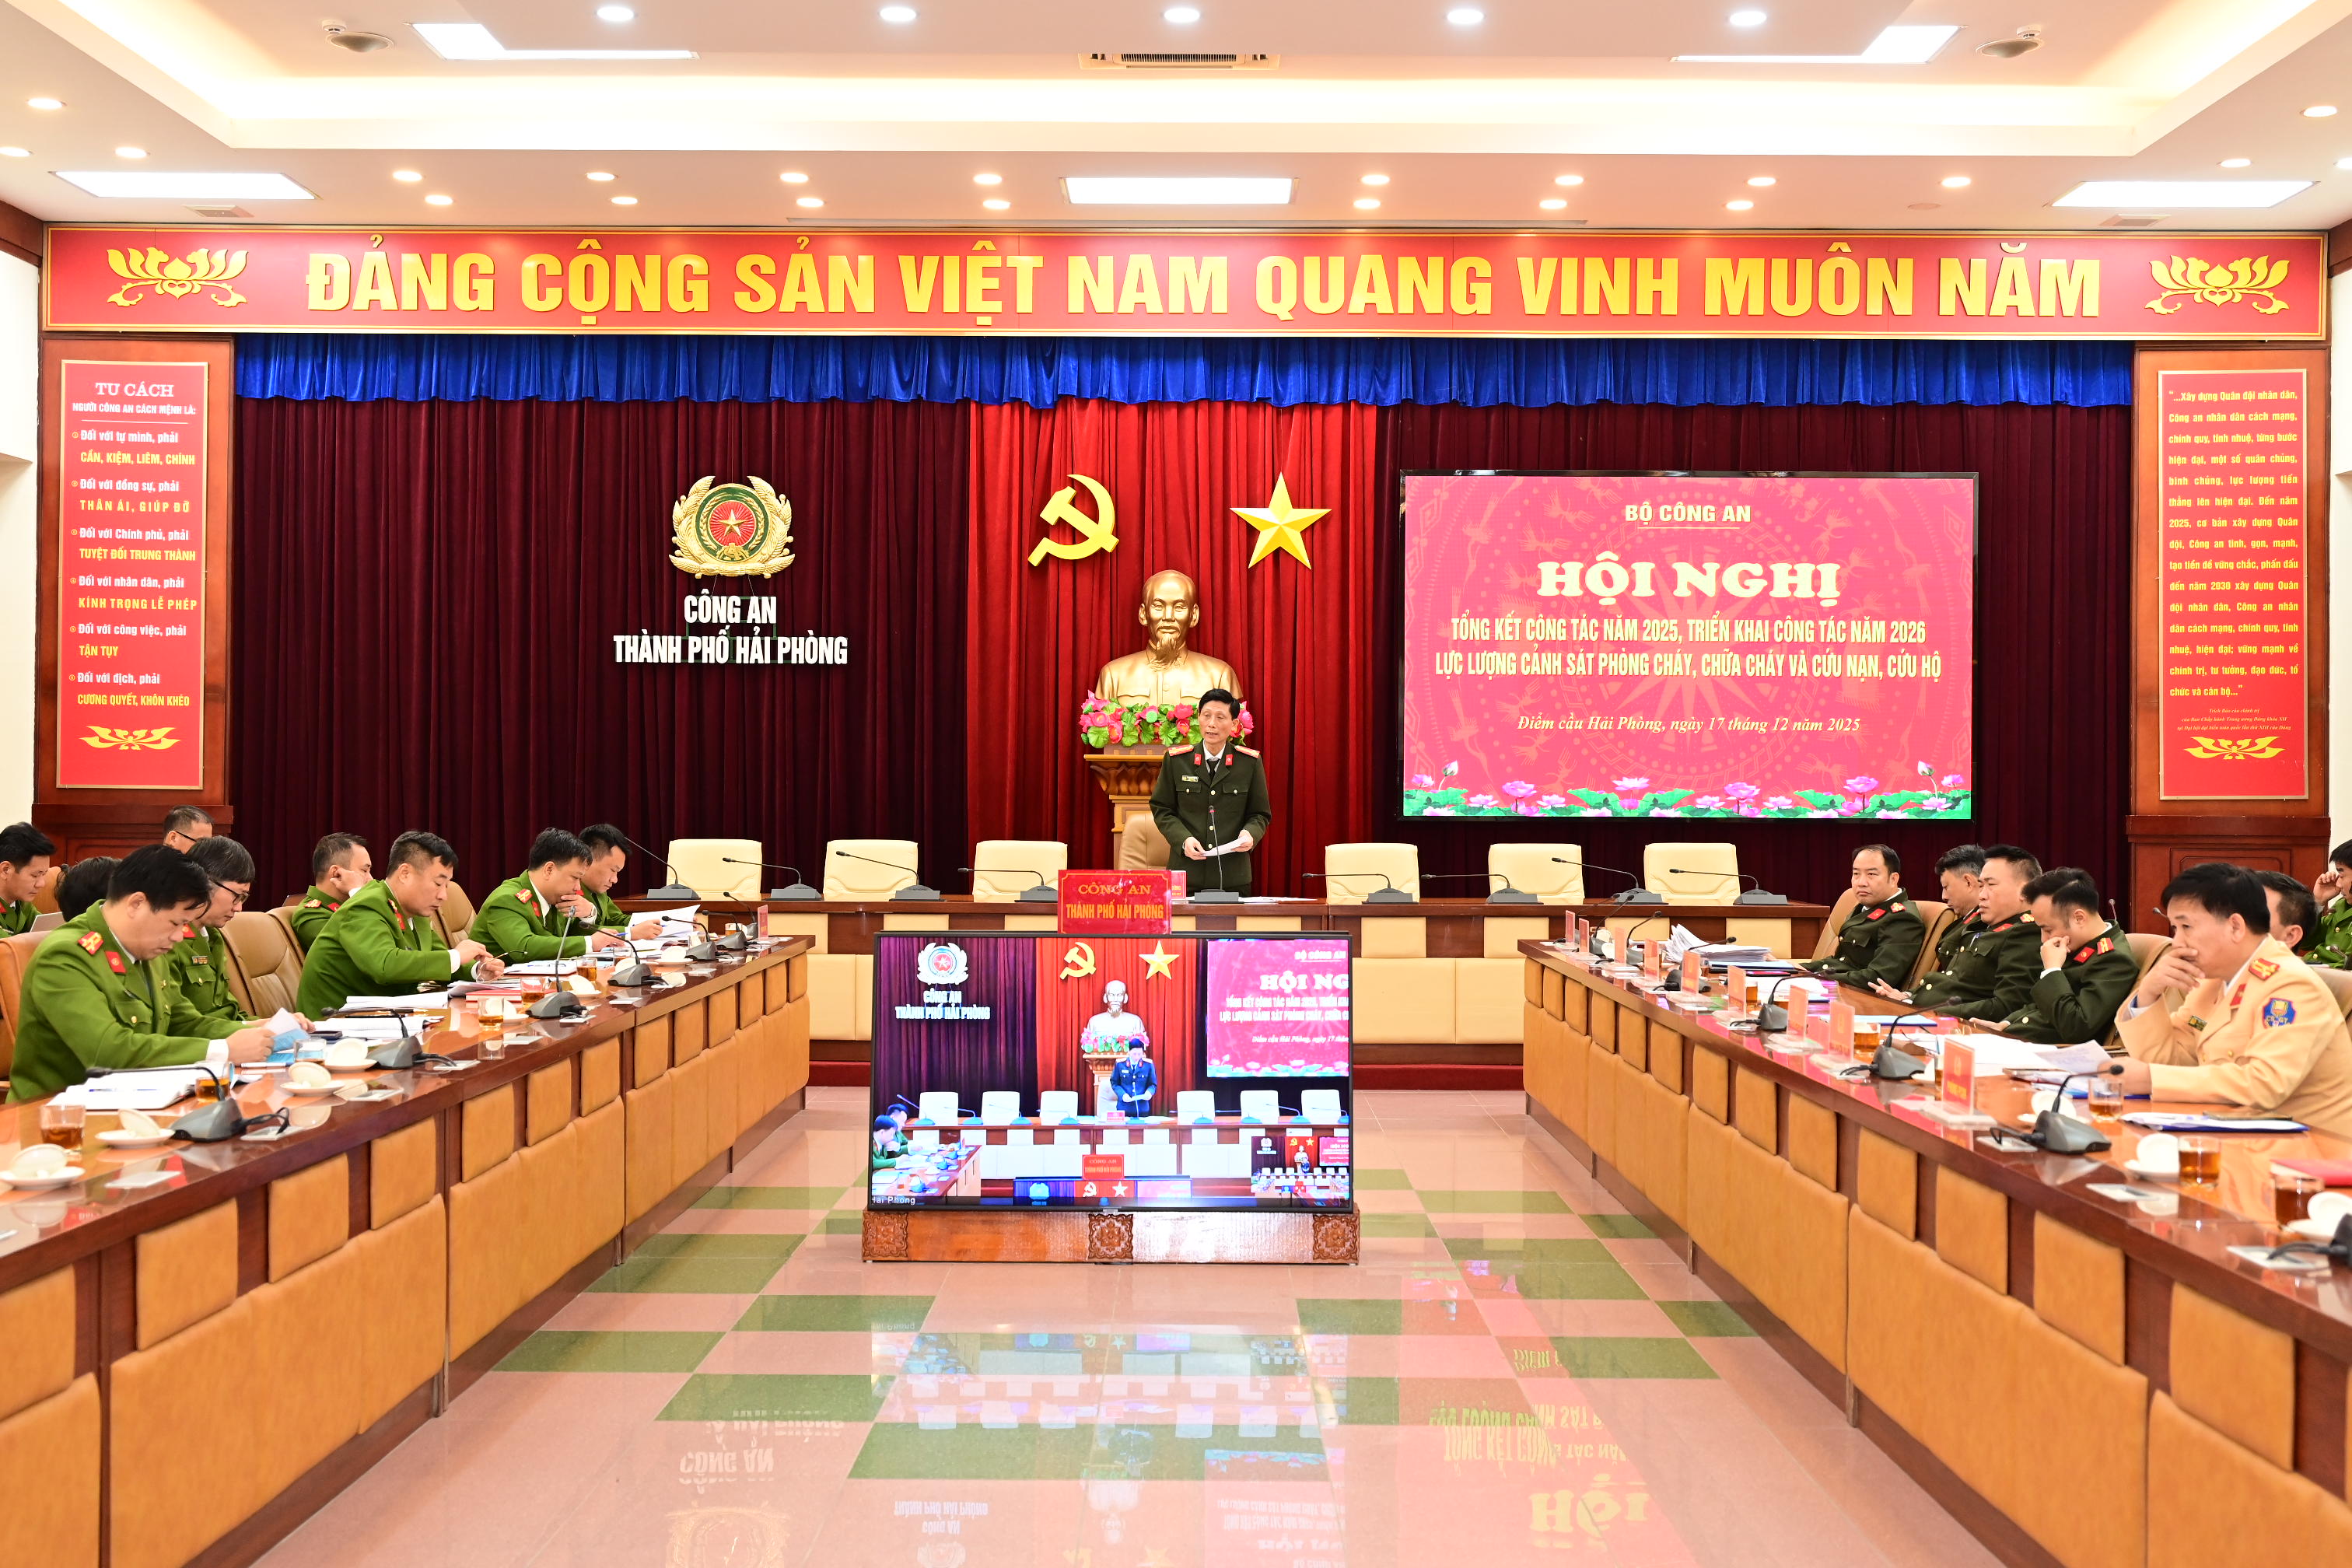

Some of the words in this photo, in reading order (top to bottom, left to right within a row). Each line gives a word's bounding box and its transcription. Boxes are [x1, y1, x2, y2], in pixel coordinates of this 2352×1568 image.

[306, 234, 495, 311] ĐẢNG
[521, 239, 709, 325] CỘNG
[733, 236, 875, 313] SẢN
[898, 240, 1044, 326] VIỆT
[1067, 255, 1228, 313] NAM
[1255, 254, 1492, 321] QUANG
[1516, 257, 1678, 315] VINH
[1705, 242, 1914, 317] MUÔN
[1939, 242, 2100, 317] NĂM
[124, 381, 173, 397] CÁCH
[122, 404, 133, 412] AN
[136, 403, 156, 413] CÁCH
[184, 404, 195, 414] LÀ:
[81, 429, 96, 440] Đối
[99, 430, 113, 440] với
[116, 431, 125, 443] tự
[128, 431, 154, 443] mình,
[158, 431, 177, 443] phải
[107, 450, 133, 464] KIỆM,
[137, 451, 162, 464] LIÊM,
[166, 452, 194, 464] CHÍNH
[80, 478, 95, 488] Đối
[99, 478, 112, 489] với
[116, 478, 138, 492] đồng
[142, 481, 155, 492] sự,
[159, 479, 178, 492] phải
[80, 499, 111, 510] THÂN
[117, 499, 134, 512] ÁI,
[139, 499, 169, 512] GIÚP
[1626, 502, 1652, 524] BỘ
[1659, 502, 1715, 521] CÔNG
[1722, 506, 1750, 521] AN
[79, 526, 95, 537] Đối
[98, 528, 112, 538] với
[115, 528, 142, 539] Chính
[145, 528, 165, 541] phủ,
[168, 528, 188, 541] phải
[79, 547, 107, 560] TUYỆT
[110, 547, 126, 559] ĐỐI
[130, 549, 161, 560] TRUNG
[164, 548, 195, 560] THÀNH
[79, 574, 93, 586] Đối
[97, 576, 110, 586] với
[114, 576, 137, 586] nhân
[141, 576, 160, 588] dân,
[163, 576, 184, 588] phải
[1537, 551, 1655, 604] HỘI
[1671, 562, 1840, 605] NGHỊ
[79, 596, 106, 607] KÍNH
[110, 598, 147, 610] TRỌNG
[152, 597, 163, 609] LỄ
[168, 597, 196, 610] PHÉP
[684, 589, 741, 624] CÔNG
[747, 596, 777, 624] AN
[79, 621, 93, 633] Đối
[96, 623, 110, 634] với
[114, 624, 137, 635] công
[140, 624, 163, 636] việc,
[166, 624, 186, 635] phải
[1451, 610, 1489, 640] TỔNG
[1495, 611, 1522, 640] KẾT
[1526, 614, 1566, 641] CÔNG
[1570, 614, 1598, 640] TÁC
[1603, 615, 1637, 640] NĂM
[1642, 619, 1682, 642] 2025,
[1687, 611, 1729, 641] TRIỂN
[1734, 620, 1769, 641] KHAI
[1774, 616, 1814, 642] CÔNG
[1818, 616, 1846, 642] TÁC
[1850, 617, 1885, 642] NĂM
[1890, 621, 1925, 642] 2026
[79, 643, 97, 657] TẬN
[100, 646, 117, 657] TỤY
[613, 629, 682, 663] THÀNH
[688, 625, 730, 663] PHỐ
[736, 626, 772, 664] HẢI
[777, 630, 848, 664] PHÒNG
[1436, 650, 1462, 678] LỰC
[1468, 651, 1517, 679] LƯỢNG
[1521, 644, 1561, 674] CẢNH
[1566, 649, 1594, 674] SÁT
[1598, 649, 1649, 675] PHÒNG
[1654, 649, 1696, 677] CHÁY,
[1701, 649, 1741, 676] CHỮA
[1745, 649, 1784, 676] CHÁY
[1789, 650, 1808, 676] VÀ
[1812, 649, 1841, 677] CỨU
[1846, 655, 1882, 681] NẠN,
[1888, 649, 1916, 677] CỨU
[1921, 651, 1941, 681] HỘ
[77, 670, 93, 682] Đối
[96, 672, 110, 682] với
[113, 672, 136, 684] dịch,
[139, 672, 159, 684] phải
[110, 692, 138, 705] QUYẾT,
[141, 693, 164, 705] KHÔN
[1517, 712, 1553, 729] Điểm
[1559, 712, 1583, 729] cầu
[1587, 716, 1613, 729] Hải
[1617, 716, 1664, 733] Phòng,
[1670, 717, 1703, 733] ngày
[1708, 717, 1724, 730] 17
[1728, 717, 1767, 733] tháng
[1773, 718, 1788, 730] 12
[1792, 719, 1822, 730] năm
[1827, 718, 1860, 730] 2025
[1128, 884, 1151, 894] AN
[1097, 899, 1115, 919] PHỐ
[1260, 971, 1307, 992] HỘI
